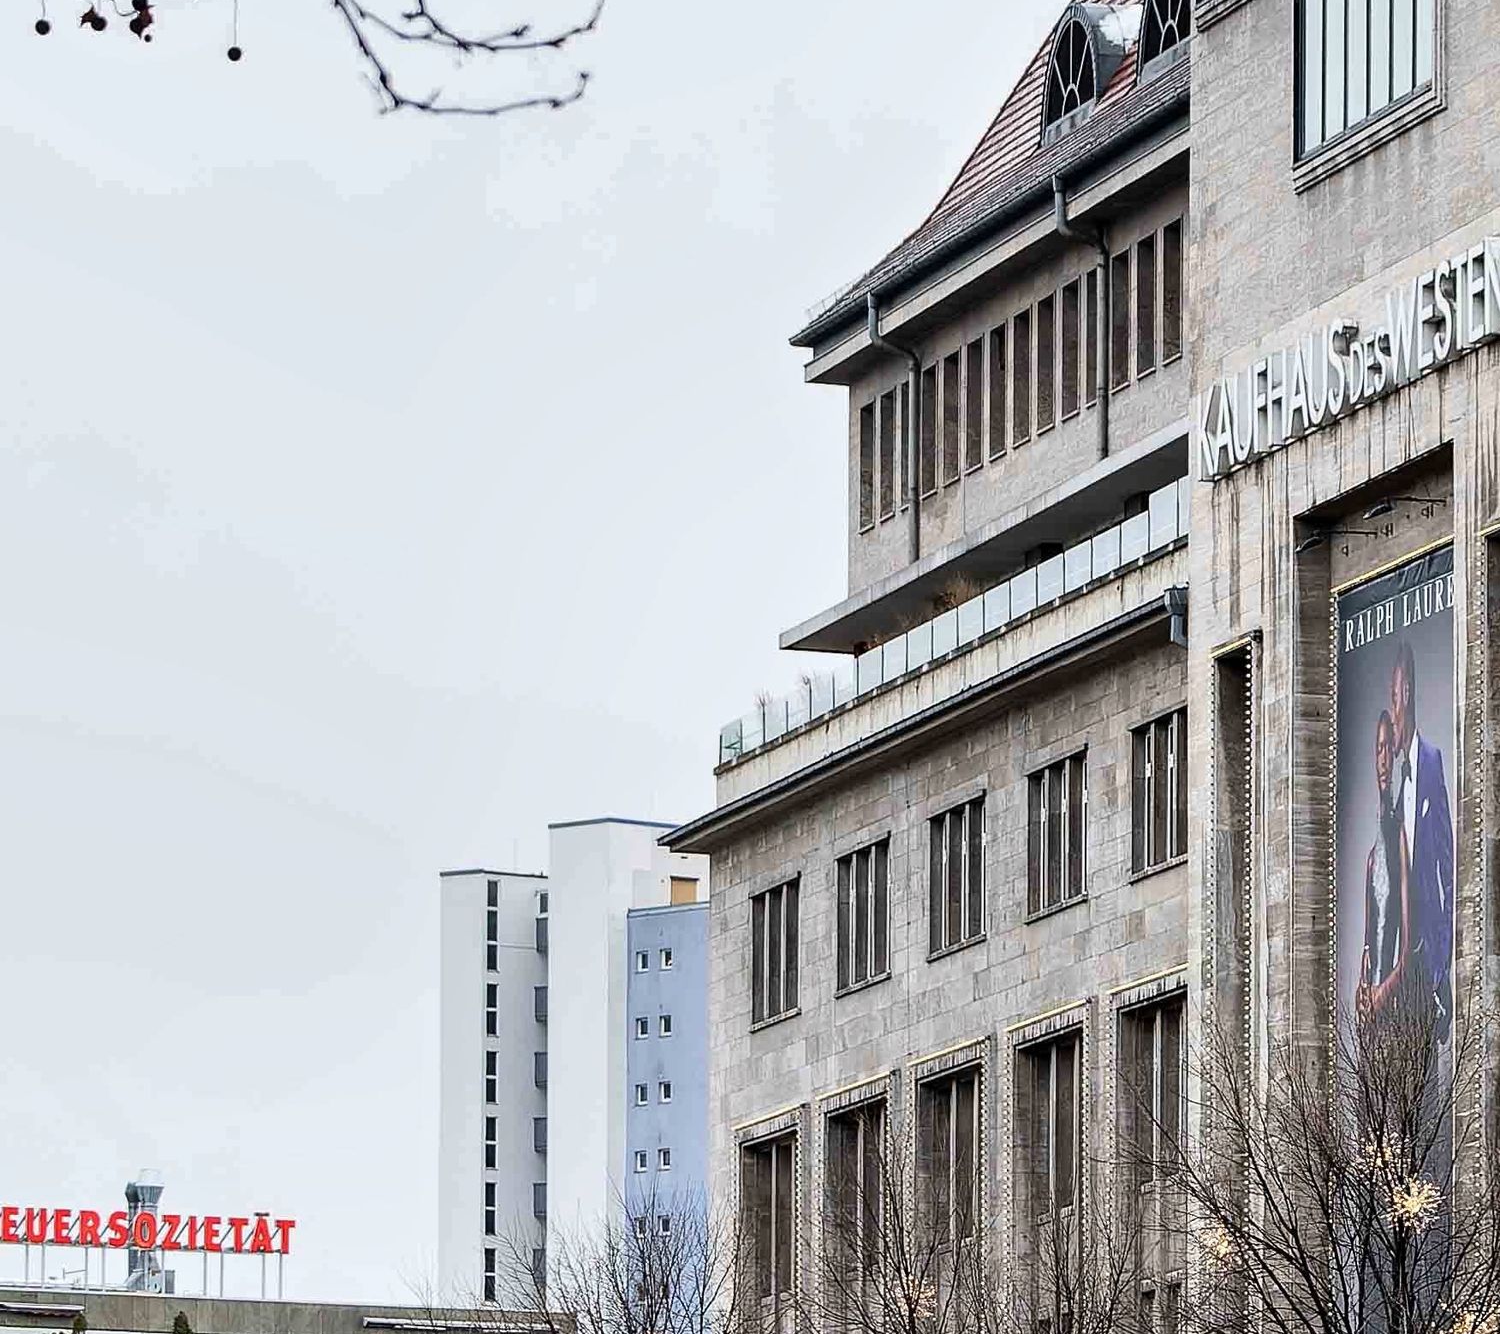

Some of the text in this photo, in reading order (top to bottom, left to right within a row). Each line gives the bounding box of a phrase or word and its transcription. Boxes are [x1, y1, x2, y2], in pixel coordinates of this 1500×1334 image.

[1198, 319, 1358, 482] KAUFHAUS
[1350, 331, 1392, 405] DES
[1345, 600, 1395, 652] RALPH
